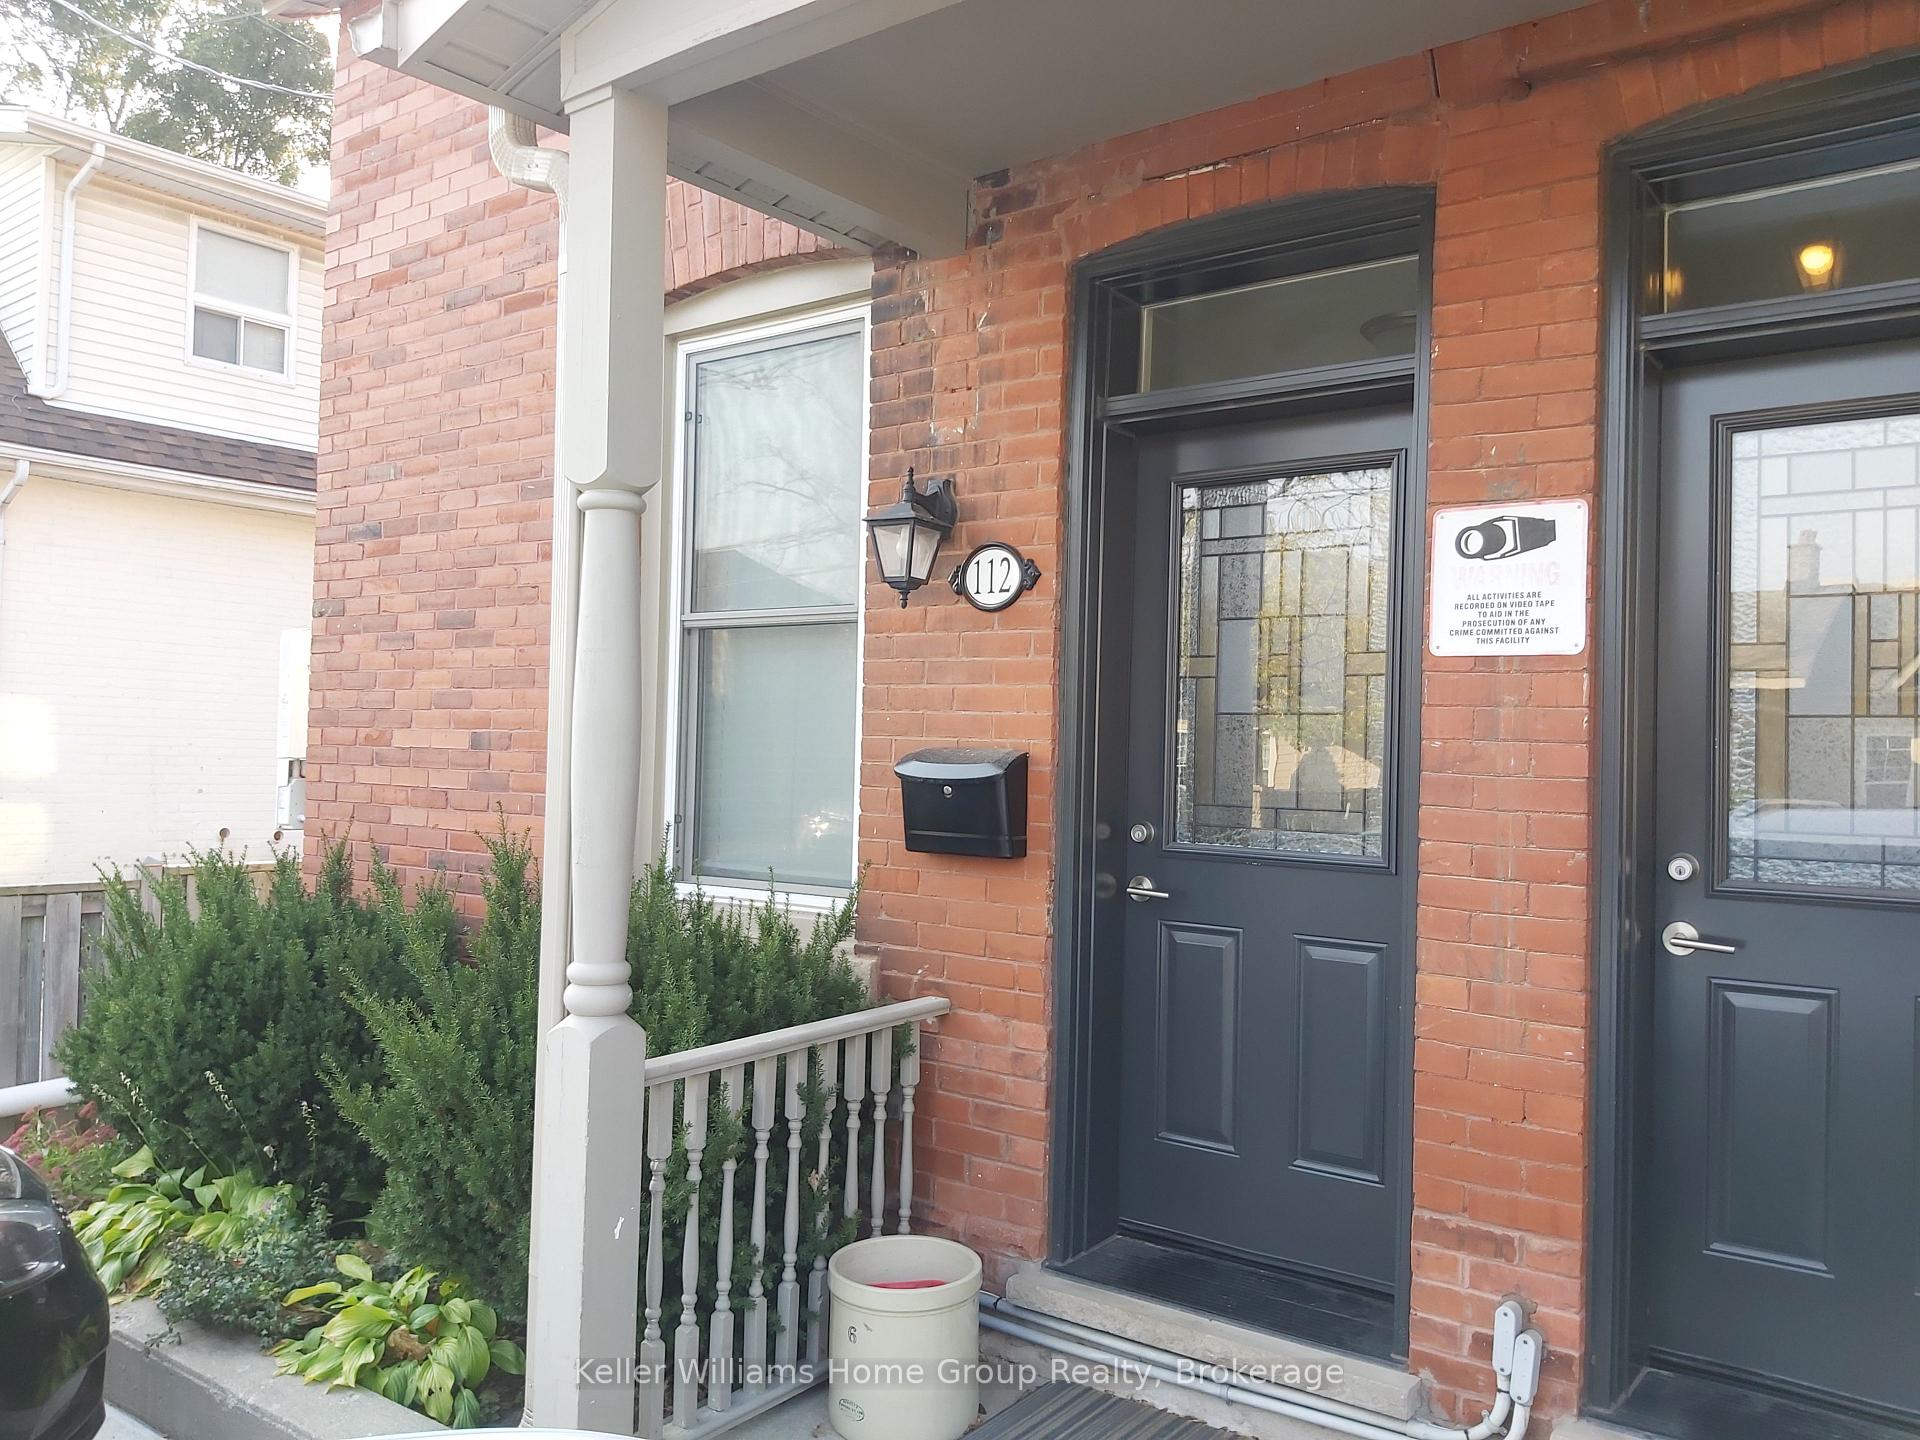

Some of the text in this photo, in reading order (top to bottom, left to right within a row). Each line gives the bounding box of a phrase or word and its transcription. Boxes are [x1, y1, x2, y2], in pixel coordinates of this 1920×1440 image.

[973, 557, 1011, 594] 112
[1467, 591, 1542, 601] ALL ACTIVITIES ARE
[1454, 602, 1495, 610] RECORDED
[1497, 601, 1507, 609] ON
[1490, 610, 1503, 618] AID
[1515, 609, 1530, 617] THE
[1462, 618, 1546, 627] PROSECUTION OF ANY
[1449, 626, 1560, 637] CRIME COMMITTED AGAINST
[1476, 636, 1530, 645] THIS FACILITY
[847, 1326, 857, 1344] 6
